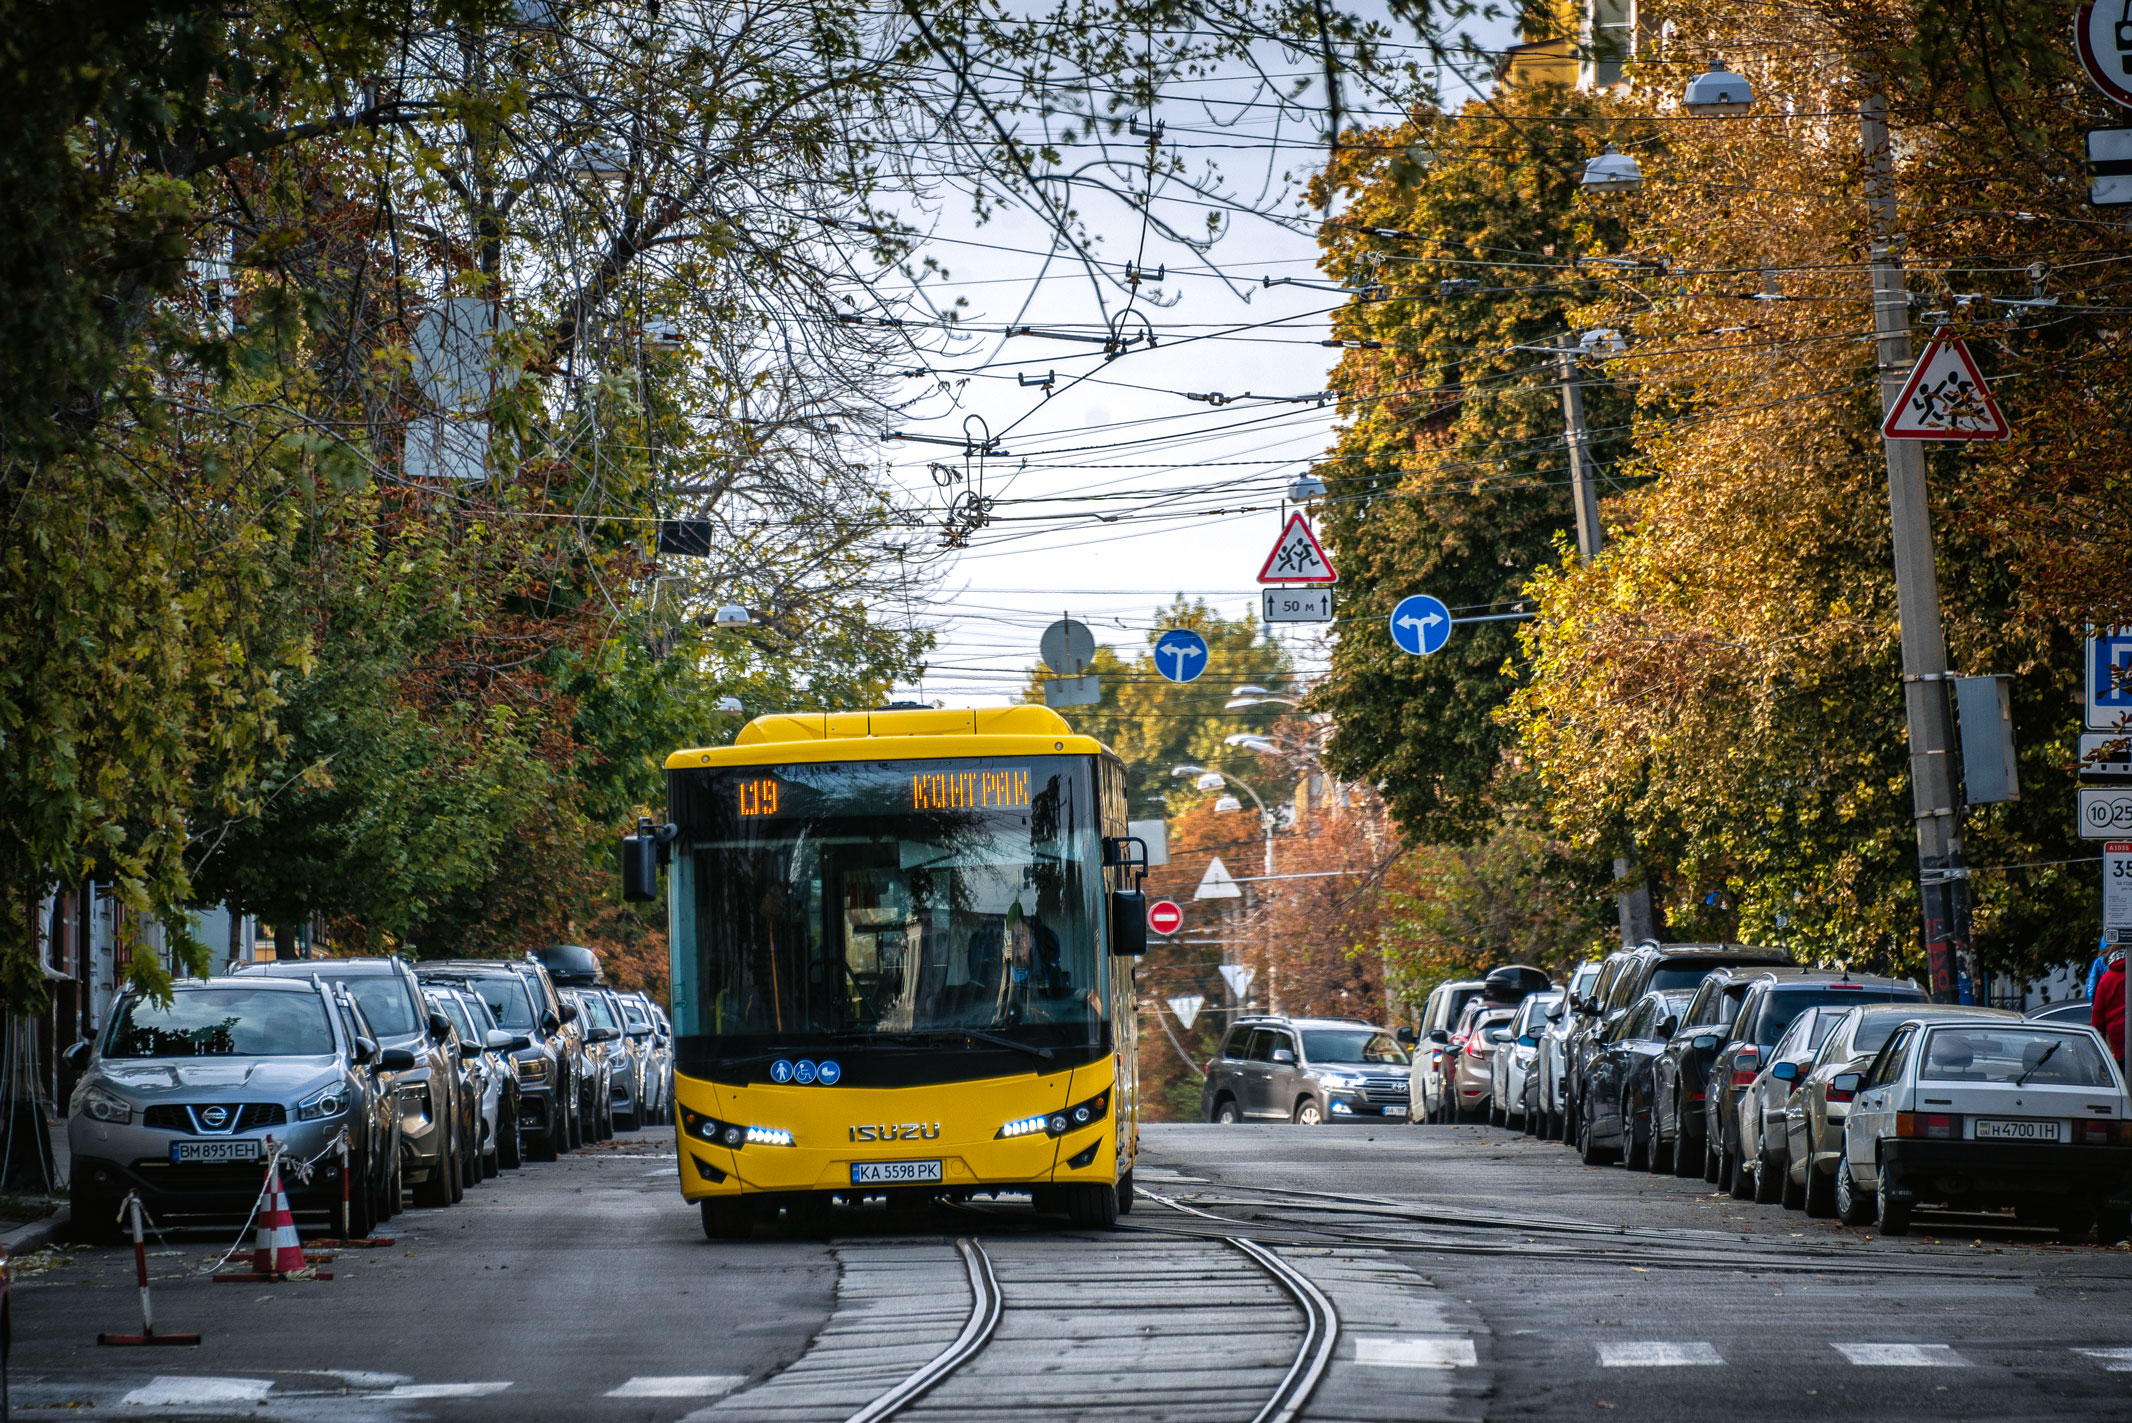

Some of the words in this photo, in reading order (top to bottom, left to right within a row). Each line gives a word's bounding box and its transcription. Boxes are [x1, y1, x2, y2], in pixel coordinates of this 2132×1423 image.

[1283, 600, 1300, 612] 50
[2091, 806, 2107, 821] 10
[849, 1122, 940, 1143] ISUZU
[2002, 1122, 2035, 1137] 4700
[884, 1164, 915, 1179] 5598
